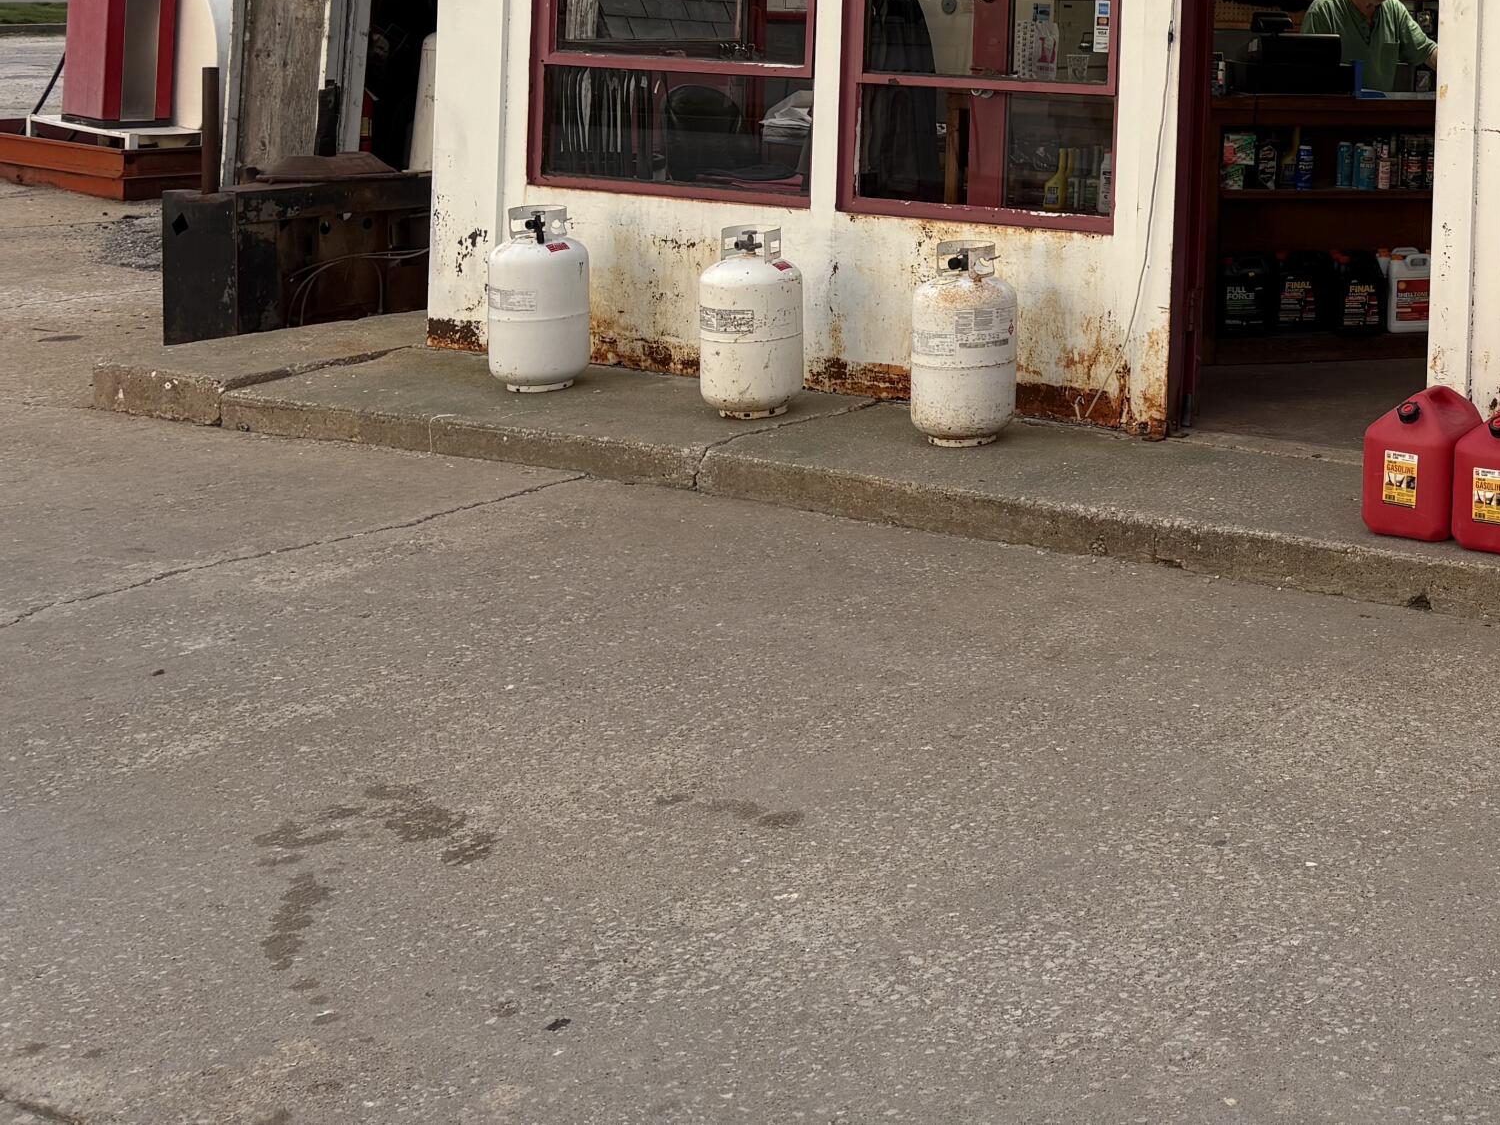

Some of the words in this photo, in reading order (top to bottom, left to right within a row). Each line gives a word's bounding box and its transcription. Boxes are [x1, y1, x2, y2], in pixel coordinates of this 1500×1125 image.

[1227, 286, 1246, 294] FULL
[1285, 281, 1312, 290] FINAL
[1349, 284, 1376, 293] FINAL
[1227, 292, 1255, 301] FORCE
[1386, 463, 1415, 475] GASOLINE
